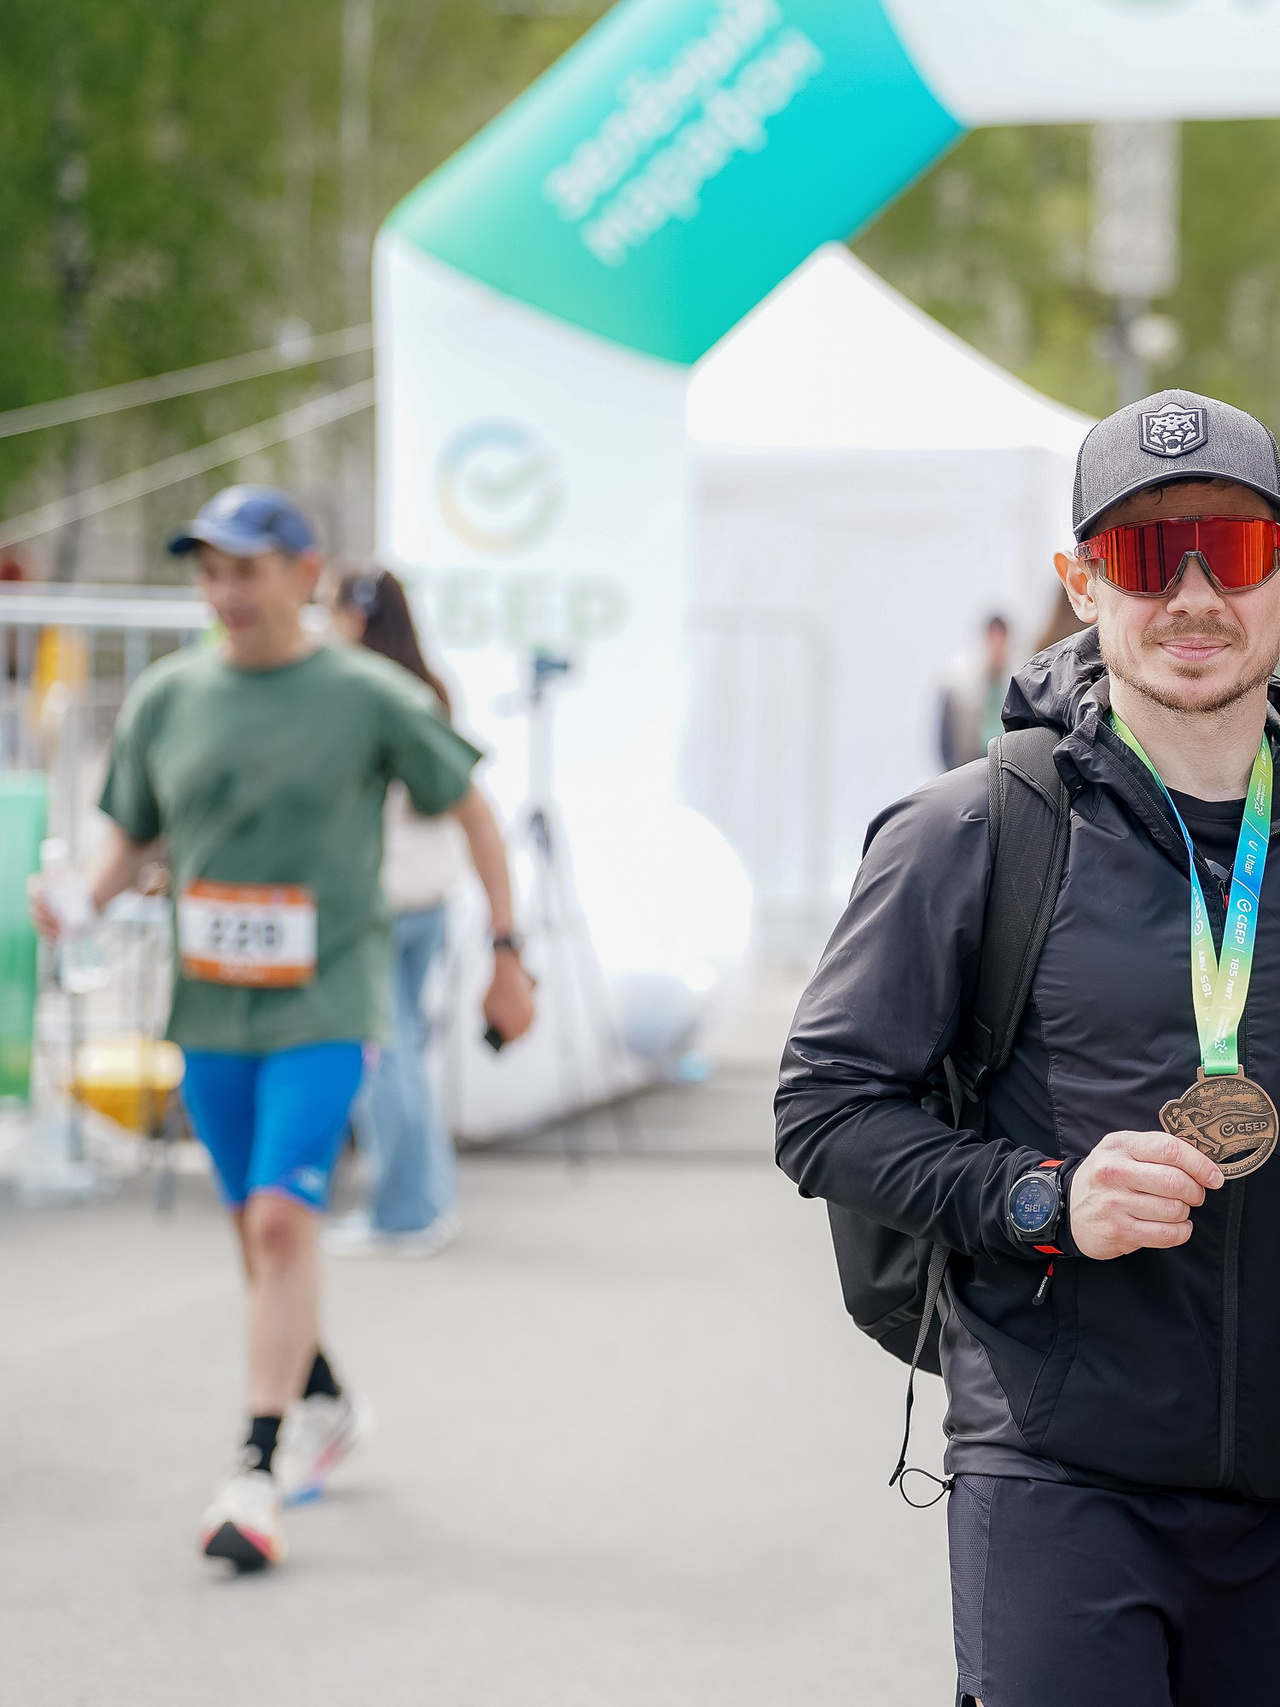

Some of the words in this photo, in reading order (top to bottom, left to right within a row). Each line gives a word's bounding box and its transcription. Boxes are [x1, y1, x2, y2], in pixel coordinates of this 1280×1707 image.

[402, 566, 633, 648] БЕР
[1244, 854, 1256, 876] Utair
[1235, 914, 1248, 944] СБЕР
[1229, 958, 1240, 977] 185
[1201, 975, 1213, 998] 185
[1225, 979, 1236, 1000] лет
[1237, 1121, 1267, 1133] СБЕР
